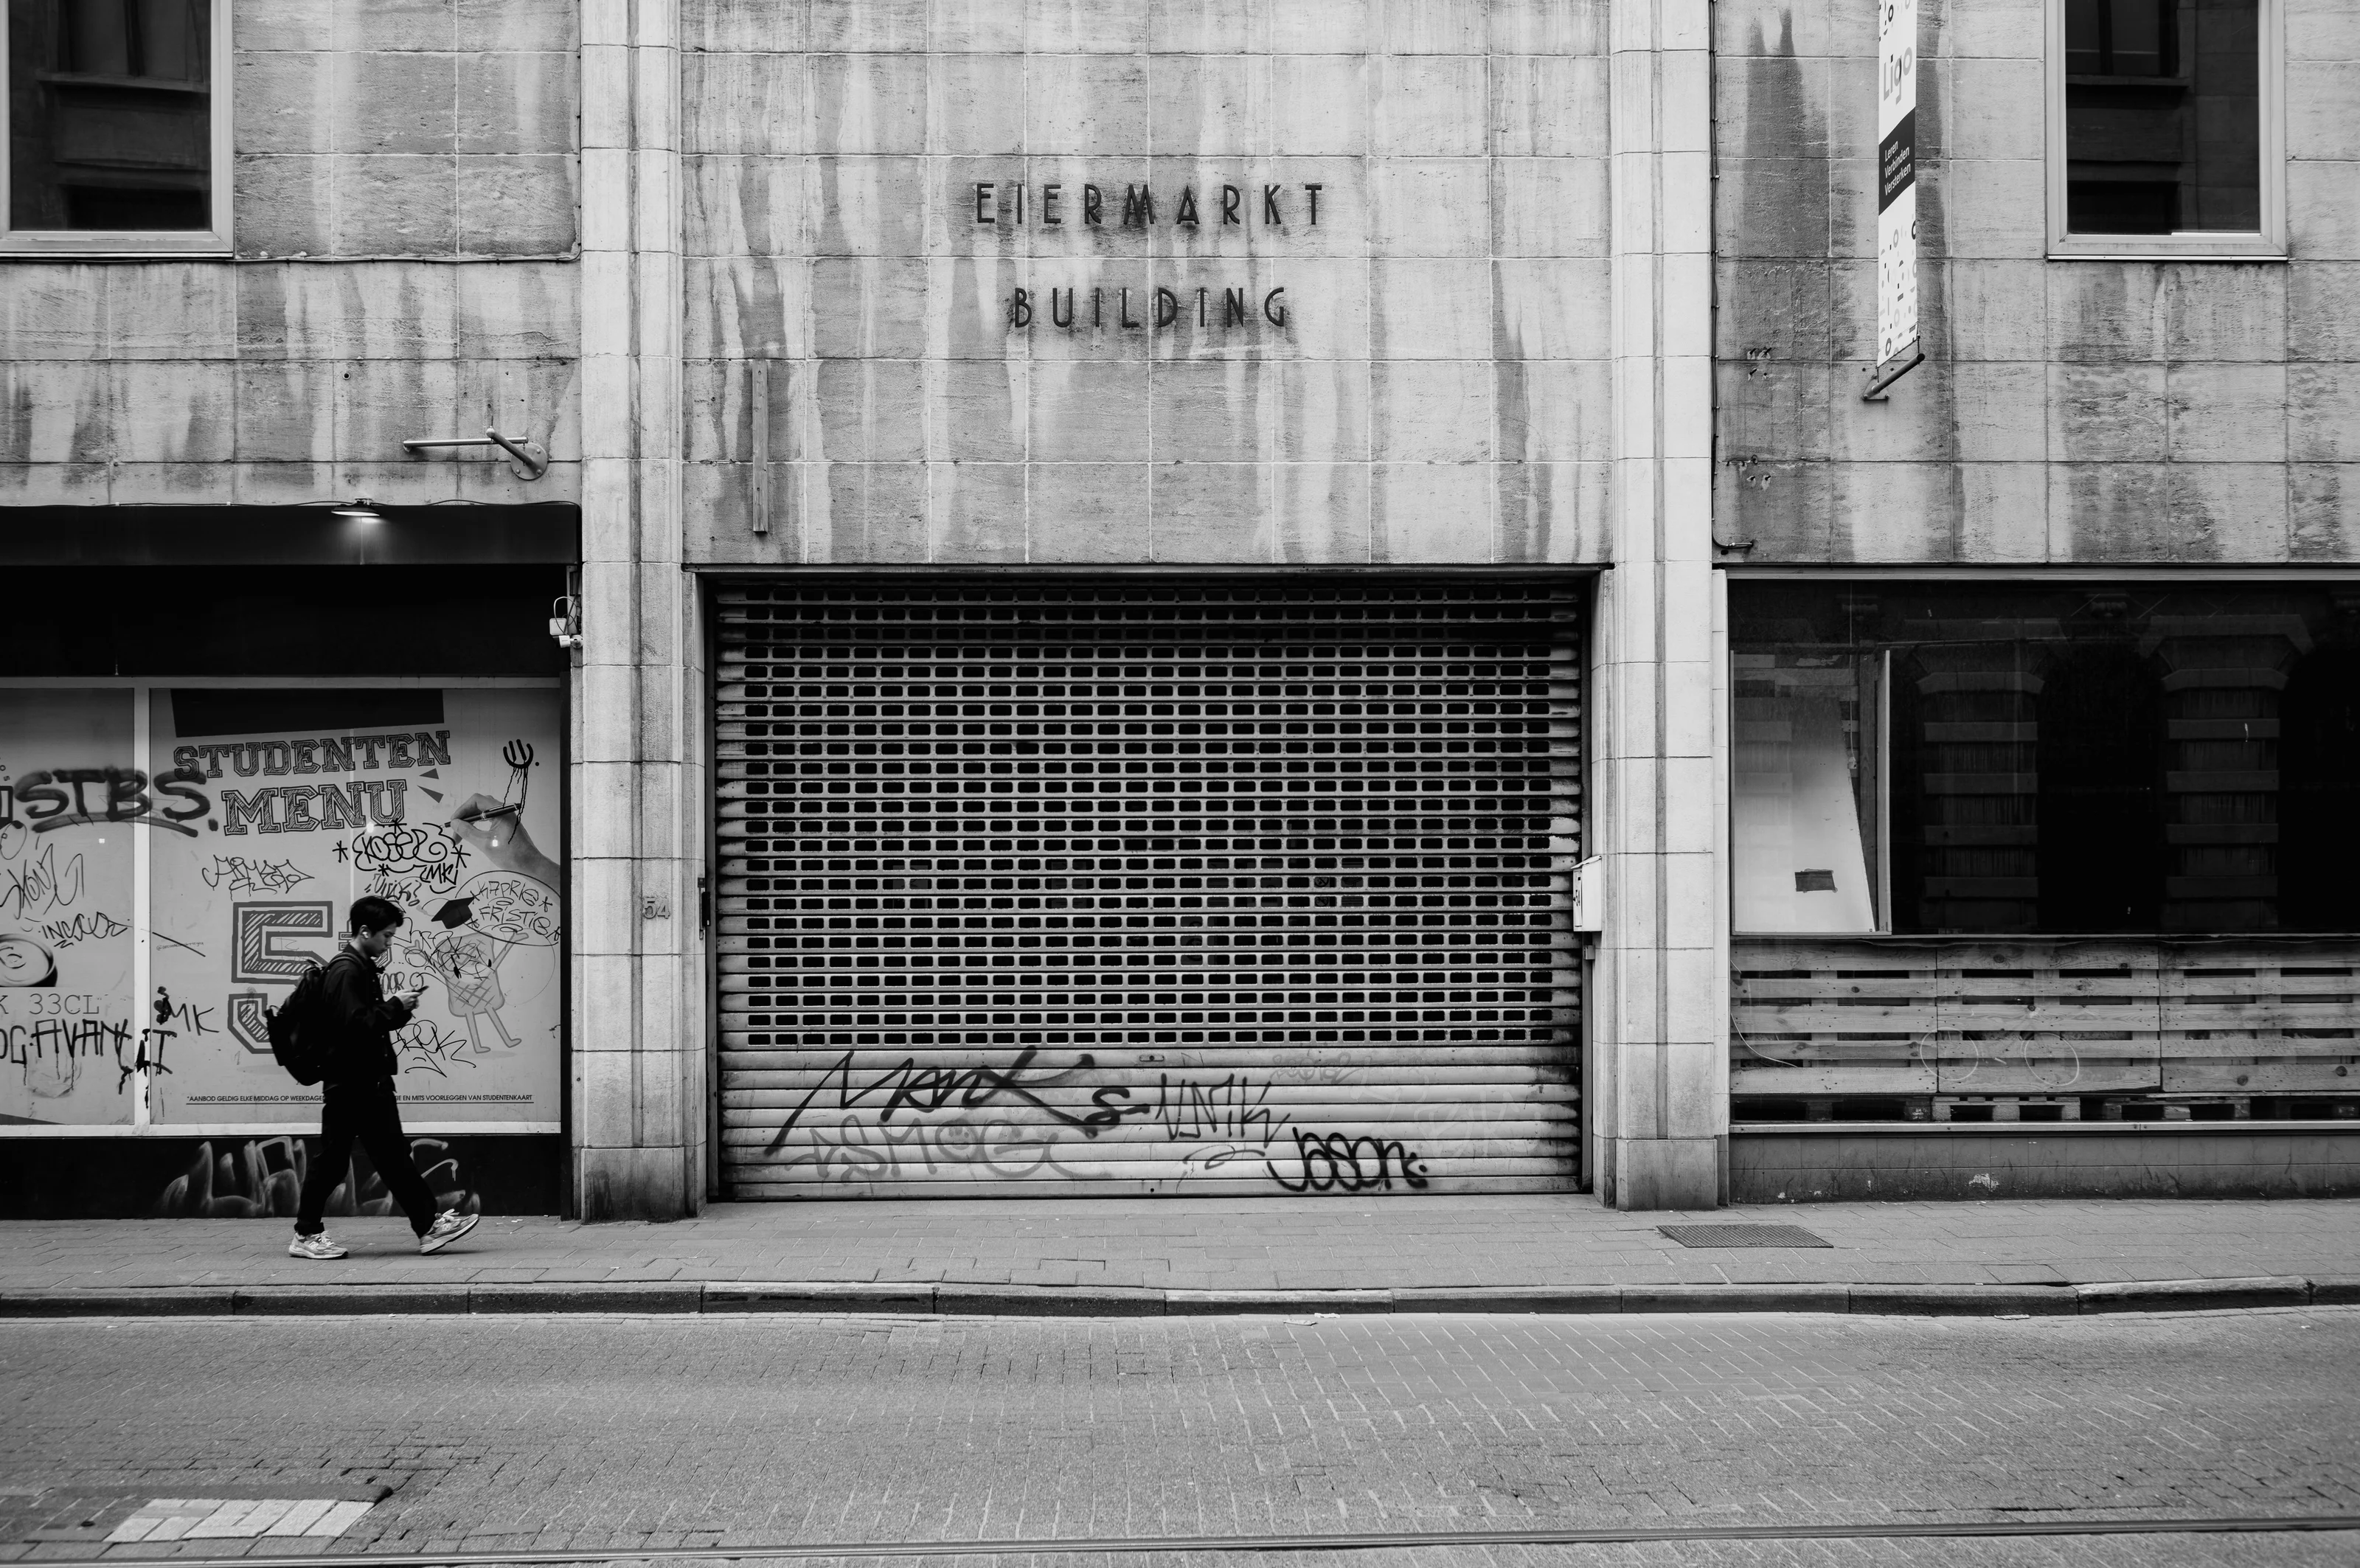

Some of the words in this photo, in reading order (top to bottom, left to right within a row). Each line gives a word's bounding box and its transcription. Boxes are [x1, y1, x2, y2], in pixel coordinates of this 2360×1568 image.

[1883, 46, 1912, 105] Ligo
[1884, 140, 1898, 162] Leren
[1884, 146, 1909, 178] Verbinden
[1884, 163, 1911, 196] Versterken
[976, 183, 1322, 225] EIERMARKT
[1014, 286, 1285, 328] BUILDING
[173, 729, 451, 780] STUDENTEN
[221, 779, 407, 836] MENU
[643, 897, 670, 920] 54
[29, 993, 100, 1015] 33CL
